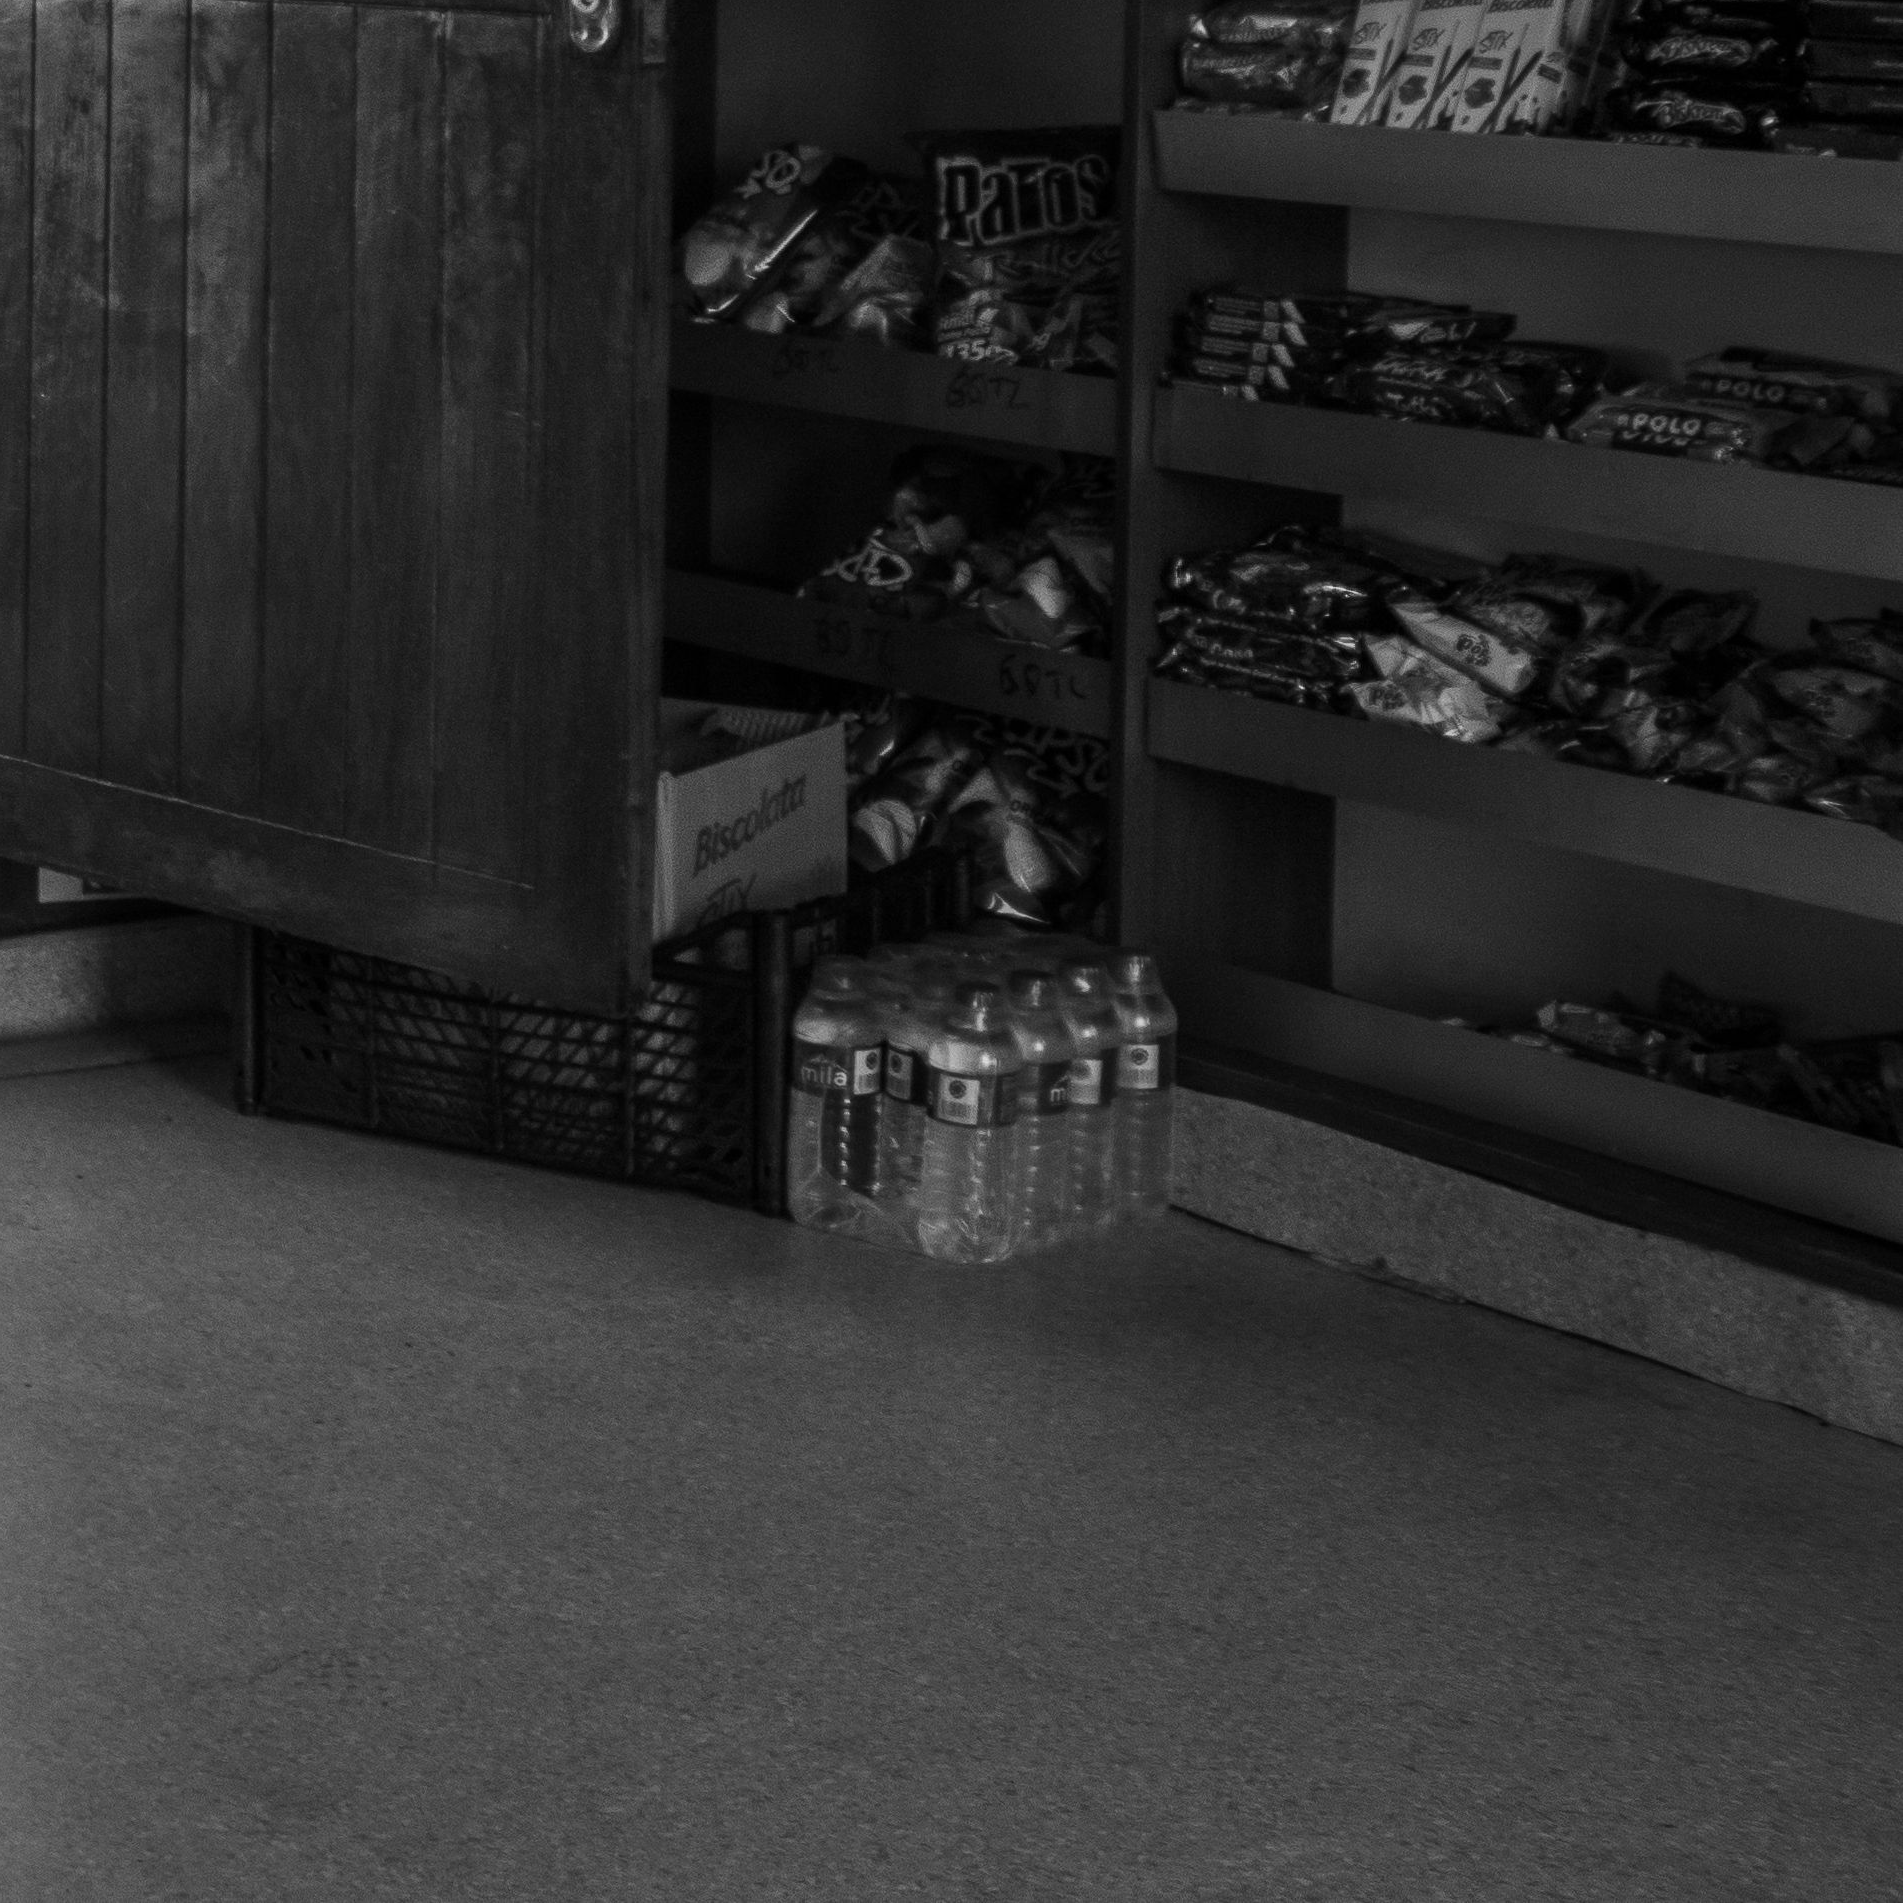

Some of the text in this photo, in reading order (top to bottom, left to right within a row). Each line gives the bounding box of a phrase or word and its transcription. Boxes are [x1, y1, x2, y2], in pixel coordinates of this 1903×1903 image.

[1715, 377, 1785, 403] POLO
[1630, 411, 1702, 437] POLO
[693, 772, 806, 878] Biscolata
